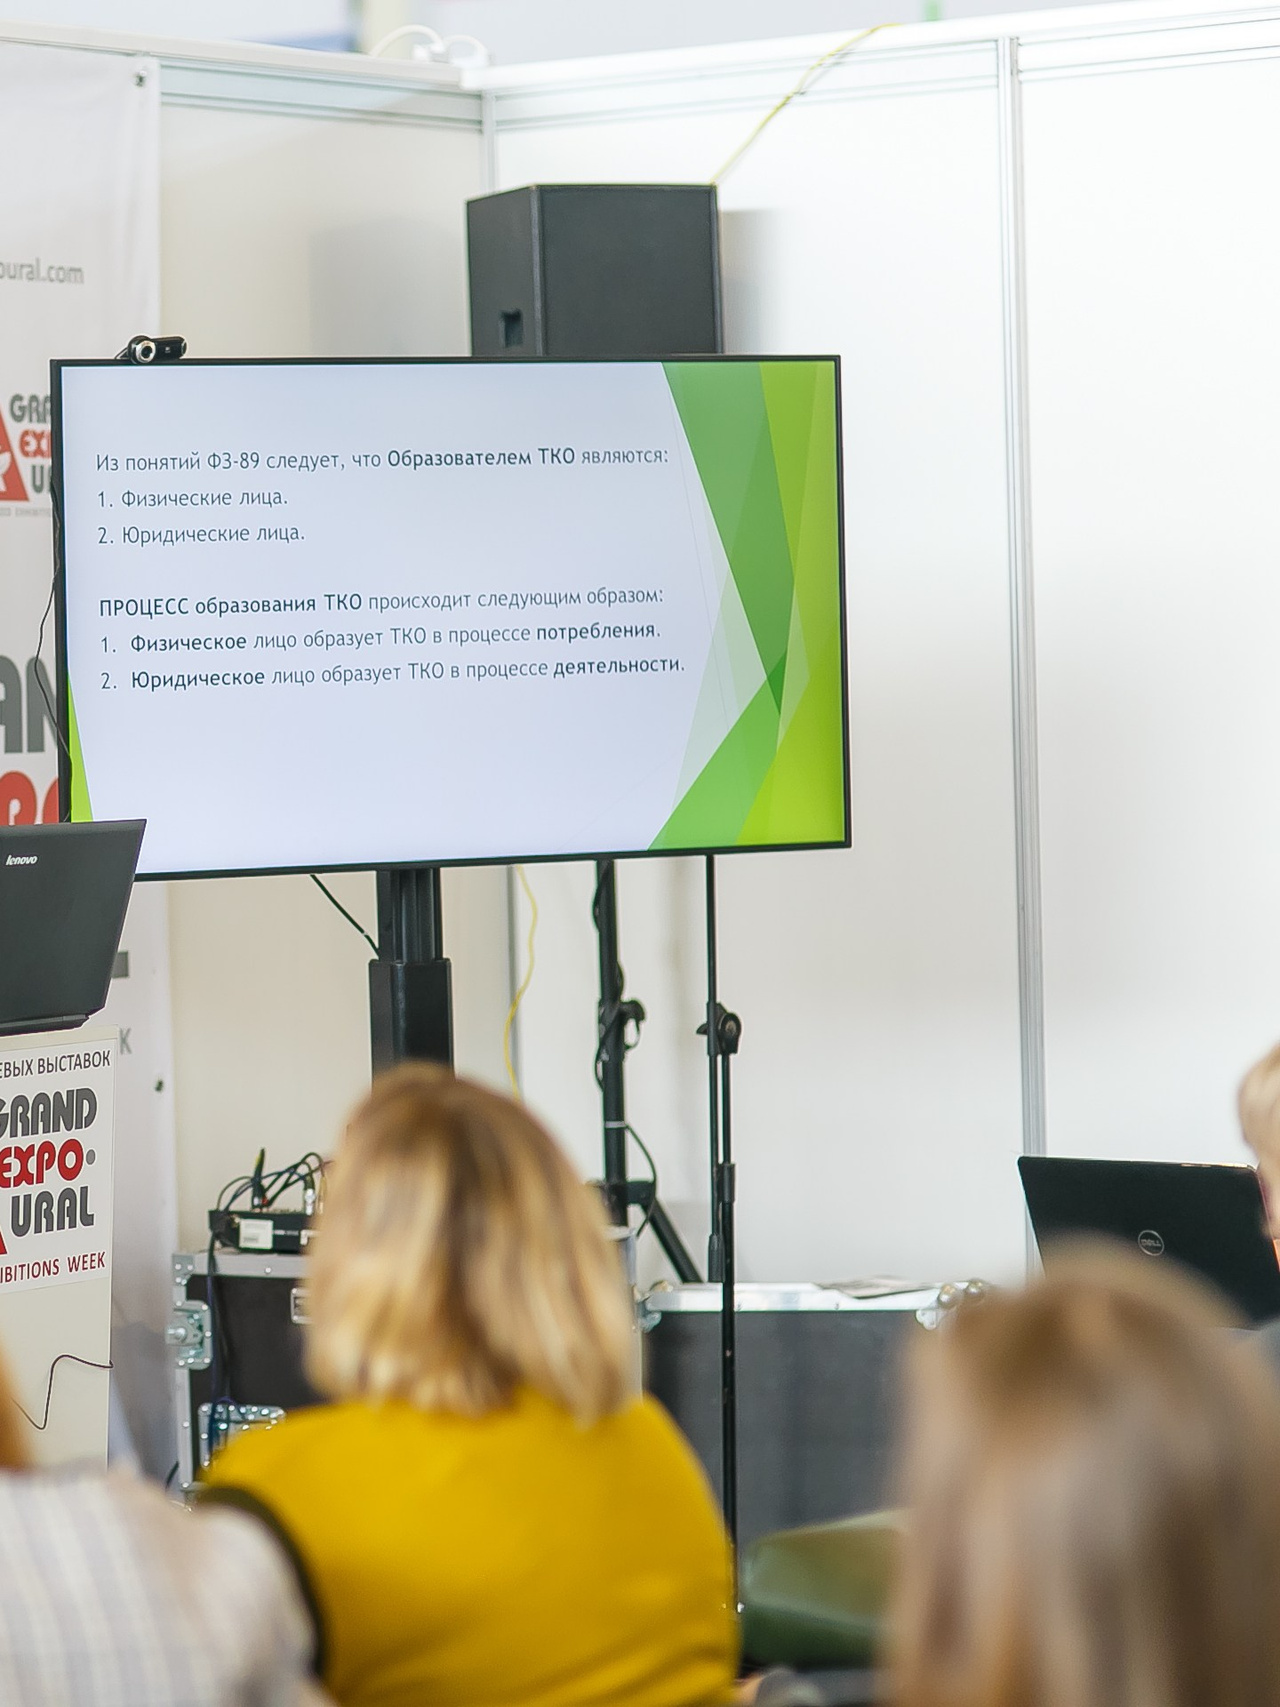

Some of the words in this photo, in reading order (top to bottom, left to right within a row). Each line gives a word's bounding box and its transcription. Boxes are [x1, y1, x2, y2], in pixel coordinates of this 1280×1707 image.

[10, 393, 52, 423] GRA
[96, 454, 119, 471] Из
[125, 452, 200, 471] понятий
[207, 451, 260, 470] ФЗ-89
[266, 454, 345, 472] следует,
[352, 454, 381, 468] что
[387, 450, 531, 470] Образователем
[537, 448, 575, 464] ТКО
[581, 449, 668, 464] являются:
[97, 491, 113, 508] 1.
[121, 489, 232, 508] Физические
[239, 491, 288, 509] лица.
[98, 527, 114, 544] 2.
[122, 526, 250, 547] Юридические
[256, 526, 305, 544] лица.
[99, 597, 189, 619] ПРОЦЕСС
[195, 596, 316, 617] образования
[324, 593, 362, 611] ТКО
[369, 591, 471, 614] происходит
[477, 589, 581, 610] следующим
[587, 586, 663, 608] образом:
[101, 636, 116, 653] 1.
[131, 633, 247, 653] Физическое
[253, 633, 297, 650] лицо
[303, 629, 383, 651] образует
[390, 627, 426, 645] ТКО
[433, 631, 442, 644] в
[448, 627, 531, 647] процессе
[536, 622, 661, 644] потребления.
[101, 672, 117, 690] 2.
[131, 670, 265, 692] Юридическое
[272, 667, 315, 685] лицо
[321, 664, 401, 686] образует
[408, 662, 444, 680] ТКО
[450, 666, 460, 679] в
[466, 662, 548, 682] процессе
[553, 657, 685, 679] деятельности.
[5, 854, 38, 866] lenovo
[38, 1050, 111, 1075] ВЫСТАВОК
[11, 1185, 95, 1237] URAL
[68, 1251, 106, 1273] WEEK
